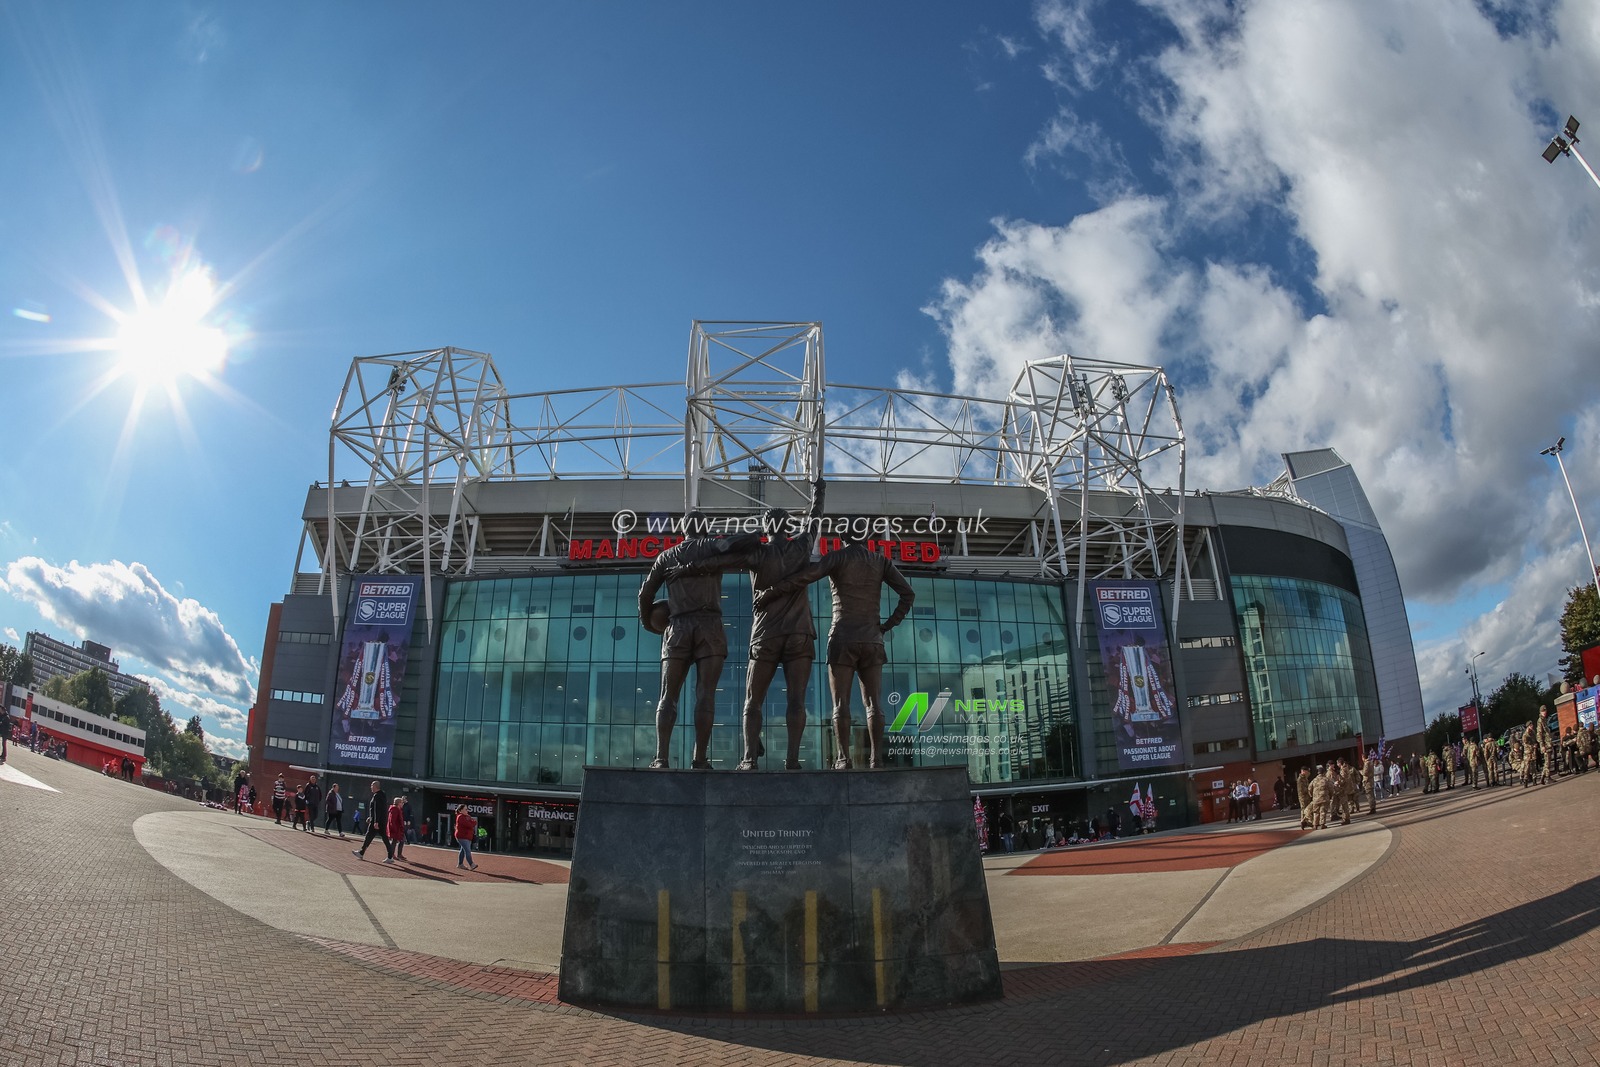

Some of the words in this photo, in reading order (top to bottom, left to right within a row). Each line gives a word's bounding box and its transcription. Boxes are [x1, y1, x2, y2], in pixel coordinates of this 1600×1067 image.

[819, 537, 940, 562] UITED
[362, 584, 410, 595] BETFRED
[1100, 589, 1148, 600] BETFRED
[377, 602, 406, 612] SUPER
[1122, 606, 1151, 615] SUPER
[376, 611, 405, 619] LEAGUE
[1124, 615, 1152, 623] LEAGUE
[348, 735, 375, 743] BETFRED
[1136, 737, 1162, 745] BETFRED
[335, 743, 367, 752] PASSIONATE
[368, 746, 387, 754] ABOUT
[1123, 746, 1155, 755] PASSIONATE
[1156, 745, 1176, 753] ABOUT
[340, 751, 357, 759] SUPER
[358, 752, 380, 760] LEAGUE
[1131, 753, 1150, 761] SUPER
[1150, 752, 1171, 760] LEAGUE
[446, 803, 493, 814] MESTORE
[1031, 804, 1050, 813] EXIT
[528, 810, 575, 820] ENTRANCE
